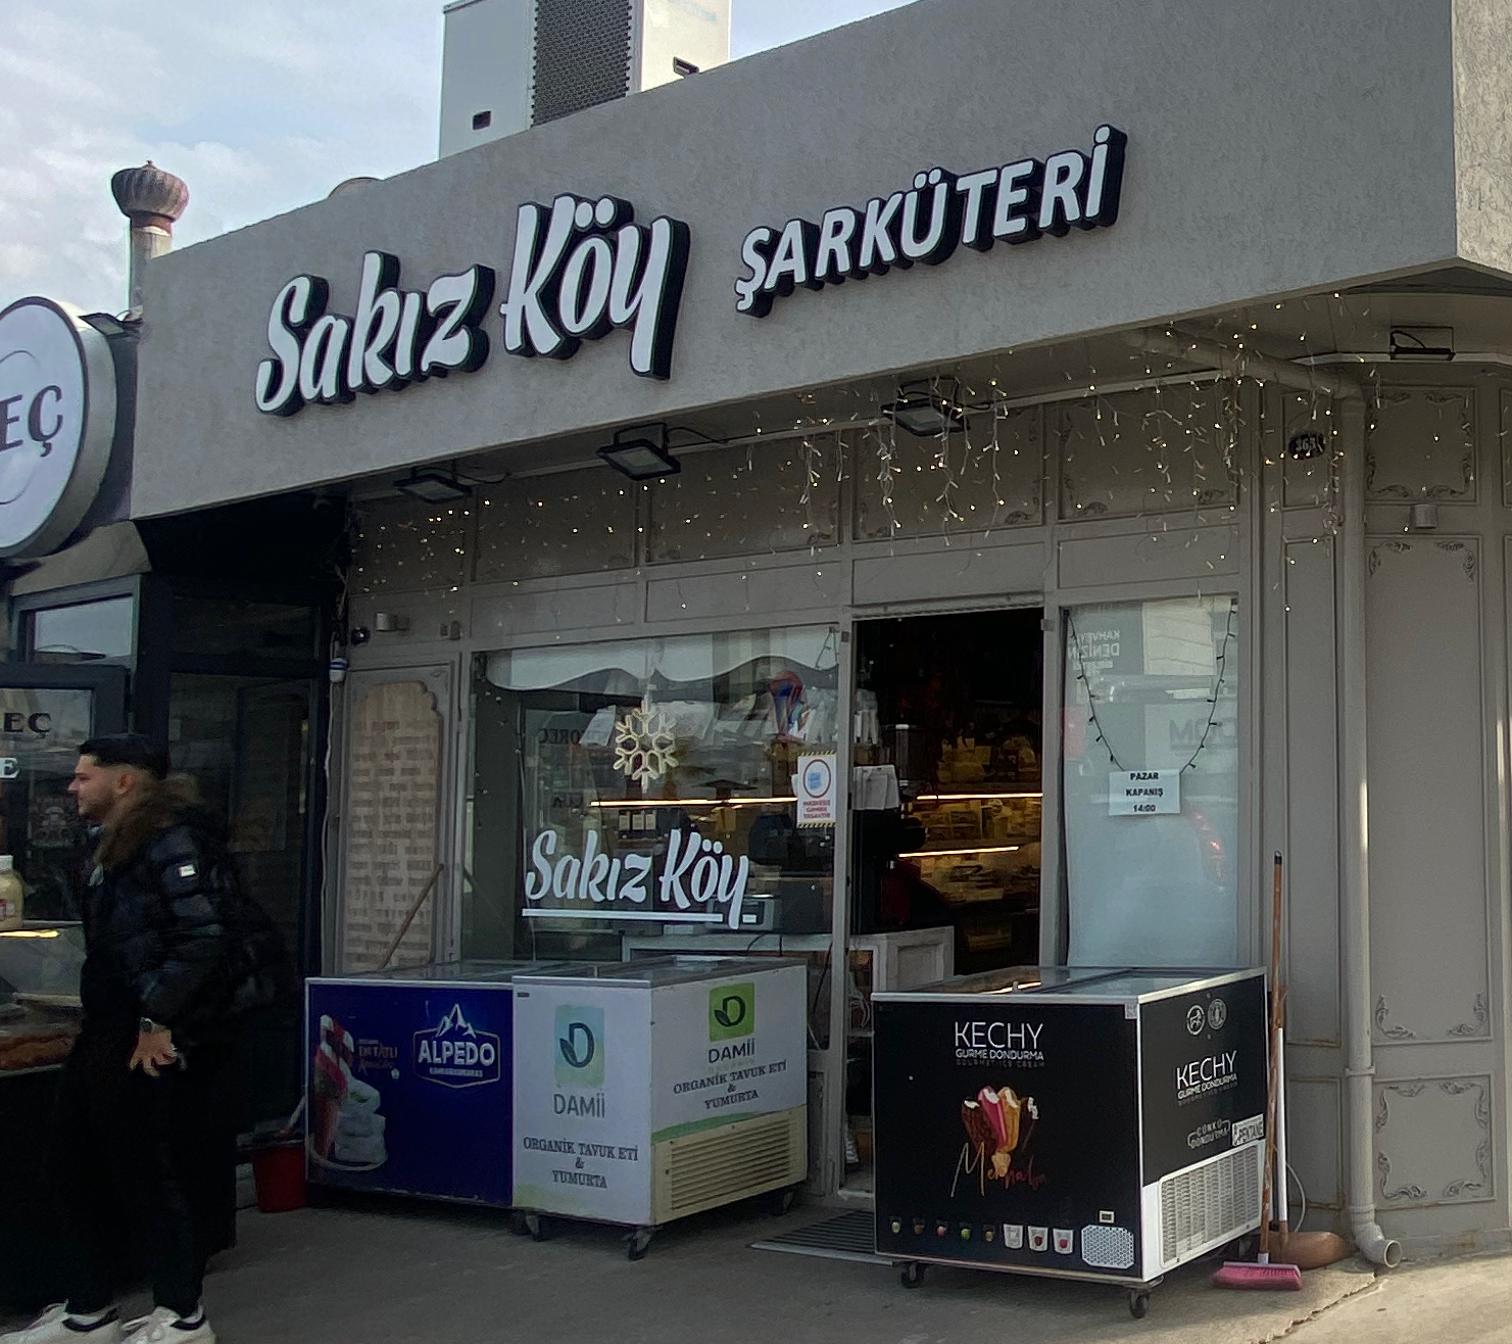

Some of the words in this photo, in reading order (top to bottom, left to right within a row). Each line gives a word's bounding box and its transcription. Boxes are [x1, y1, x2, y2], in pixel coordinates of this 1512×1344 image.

[255, 250, 490, 414] Sakız
[501, 194, 685, 378] Köy
[736, 125, 1125, 316] ŞARKÜTERİ
[1130, 772, 1159, 781] PAZAR
[1126, 787, 1164, 797] KAPANIŞ
[1133, 804, 1156, 813] 14:00
[525, 829, 653, 903] Sakız
[659, 828, 749, 930] Köy
[954, 1021, 1044, 1049] KECHY
[418, 1040, 495, 1066] ALPEDO
[955, 1048, 988, 1059] GURME
[989, 1049, 1045, 1061] DONDURMA
[673, 1070, 728, 1094] ORGANİK
[729, 1066, 766, 1083] TAVUK
[768, 1059, 788, 1073] ETİ
[1176, 1050, 1238, 1090] KECHY
[727, 1084, 737, 1093] &
[704, 1089, 759, 1109] YUMURTA
[523, 1136, 576, 1154] ORGANİK
[578, 1142, 617, 1159] TAVUK
[617, 1145, 638, 1161] ETİ
[575, 1157, 585, 1169] &
[552, 1169, 608, 1189] YUMURTA
